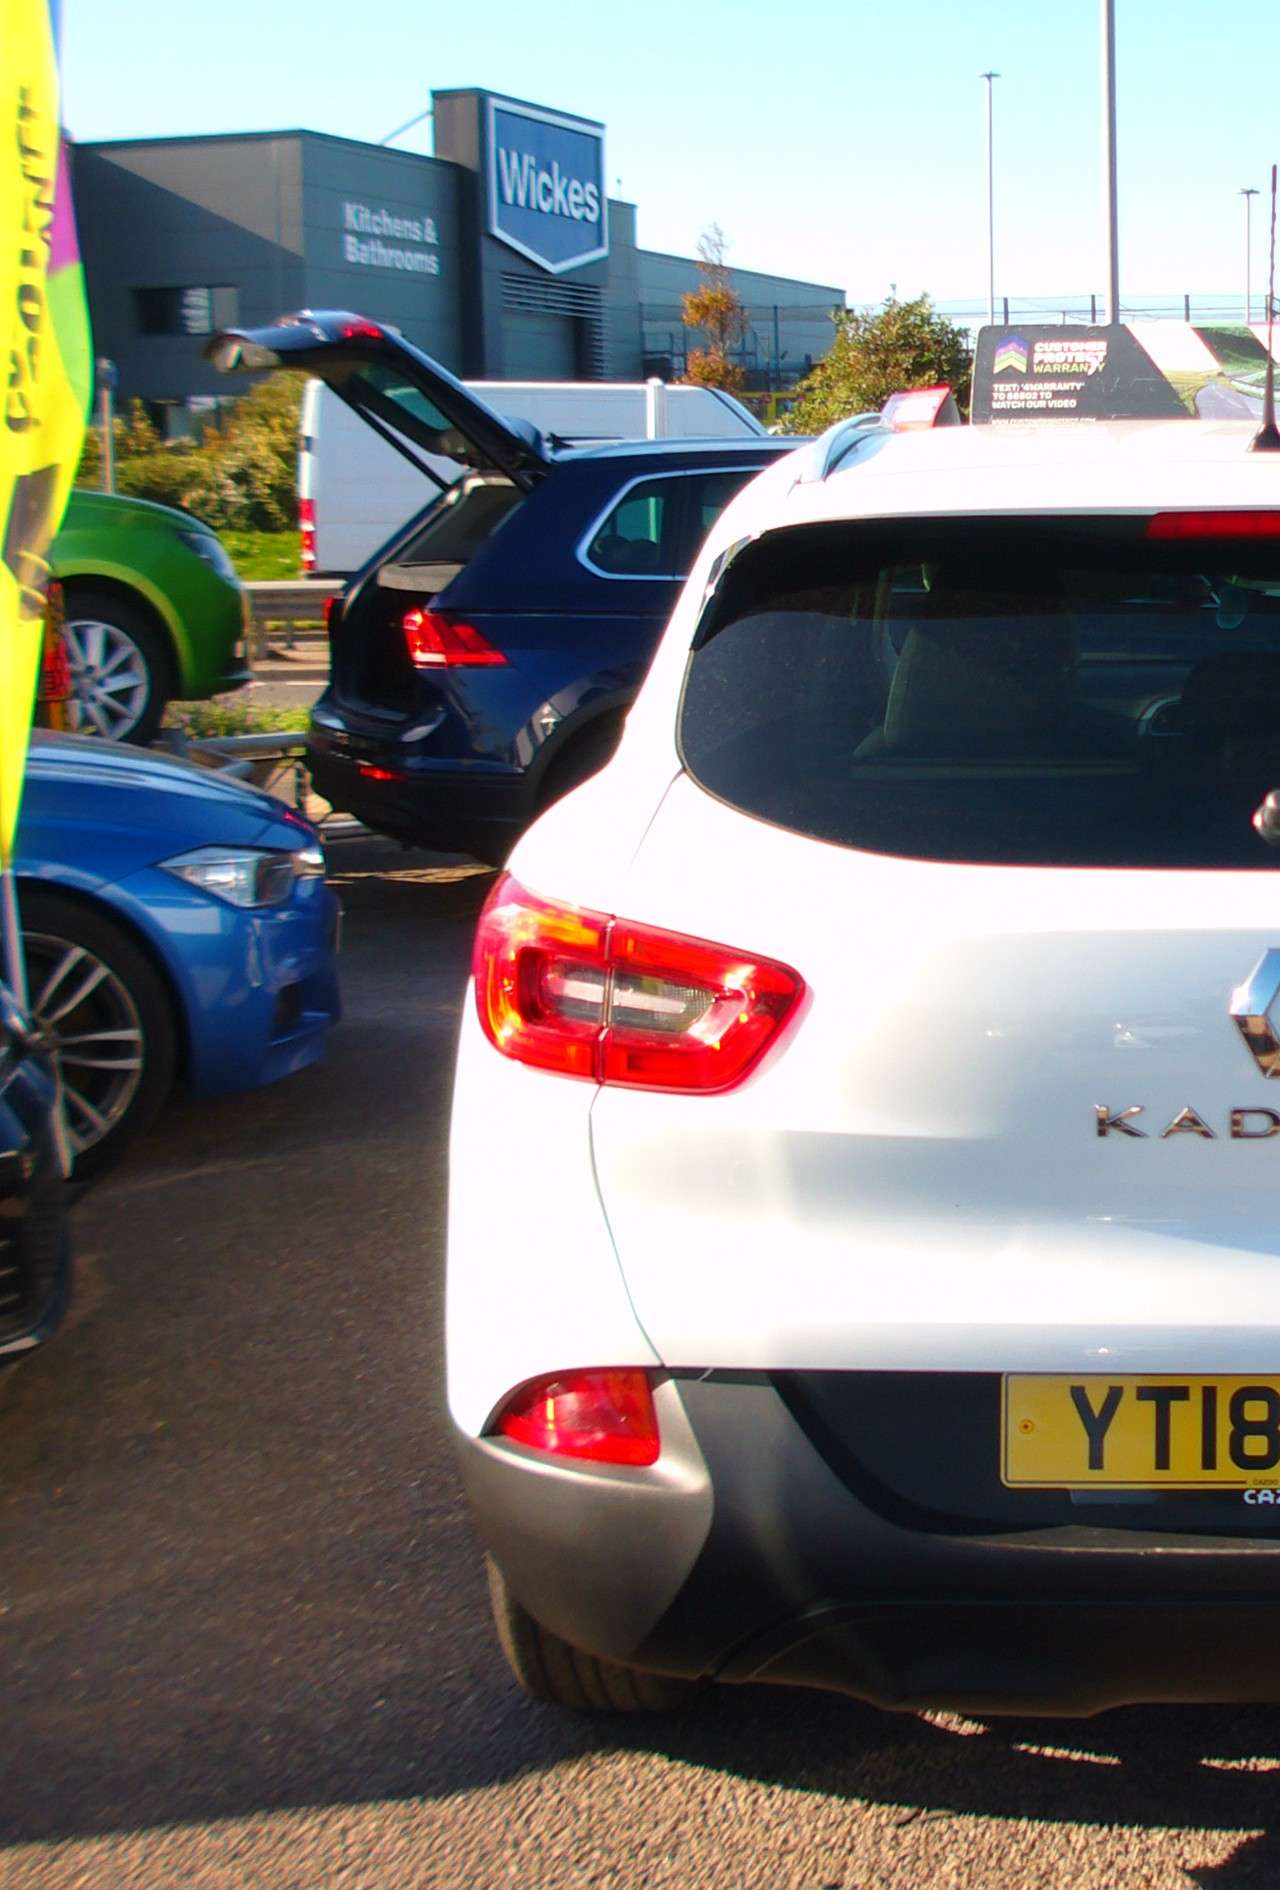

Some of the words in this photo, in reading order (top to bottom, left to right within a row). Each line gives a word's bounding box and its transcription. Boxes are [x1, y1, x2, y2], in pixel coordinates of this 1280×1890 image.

[499, 147, 600, 223] Wickes
[344, 202, 422, 240] Kitchens
[424, 218, 439, 244] &
[344, 234, 440, 275] Bathrooms
[1033, 341, 1108, 352] CUSTOMER
[1033, 351, 1107, 364] PROTECT
[992, 392, 1005, 400] TO
[1039, 391, 1052, 400] TO
[991, 400, 1025, 409] WATCH
[1026, 400, 1047, 408] OUR
[1047, 399, 1077, 408] VIDEO
